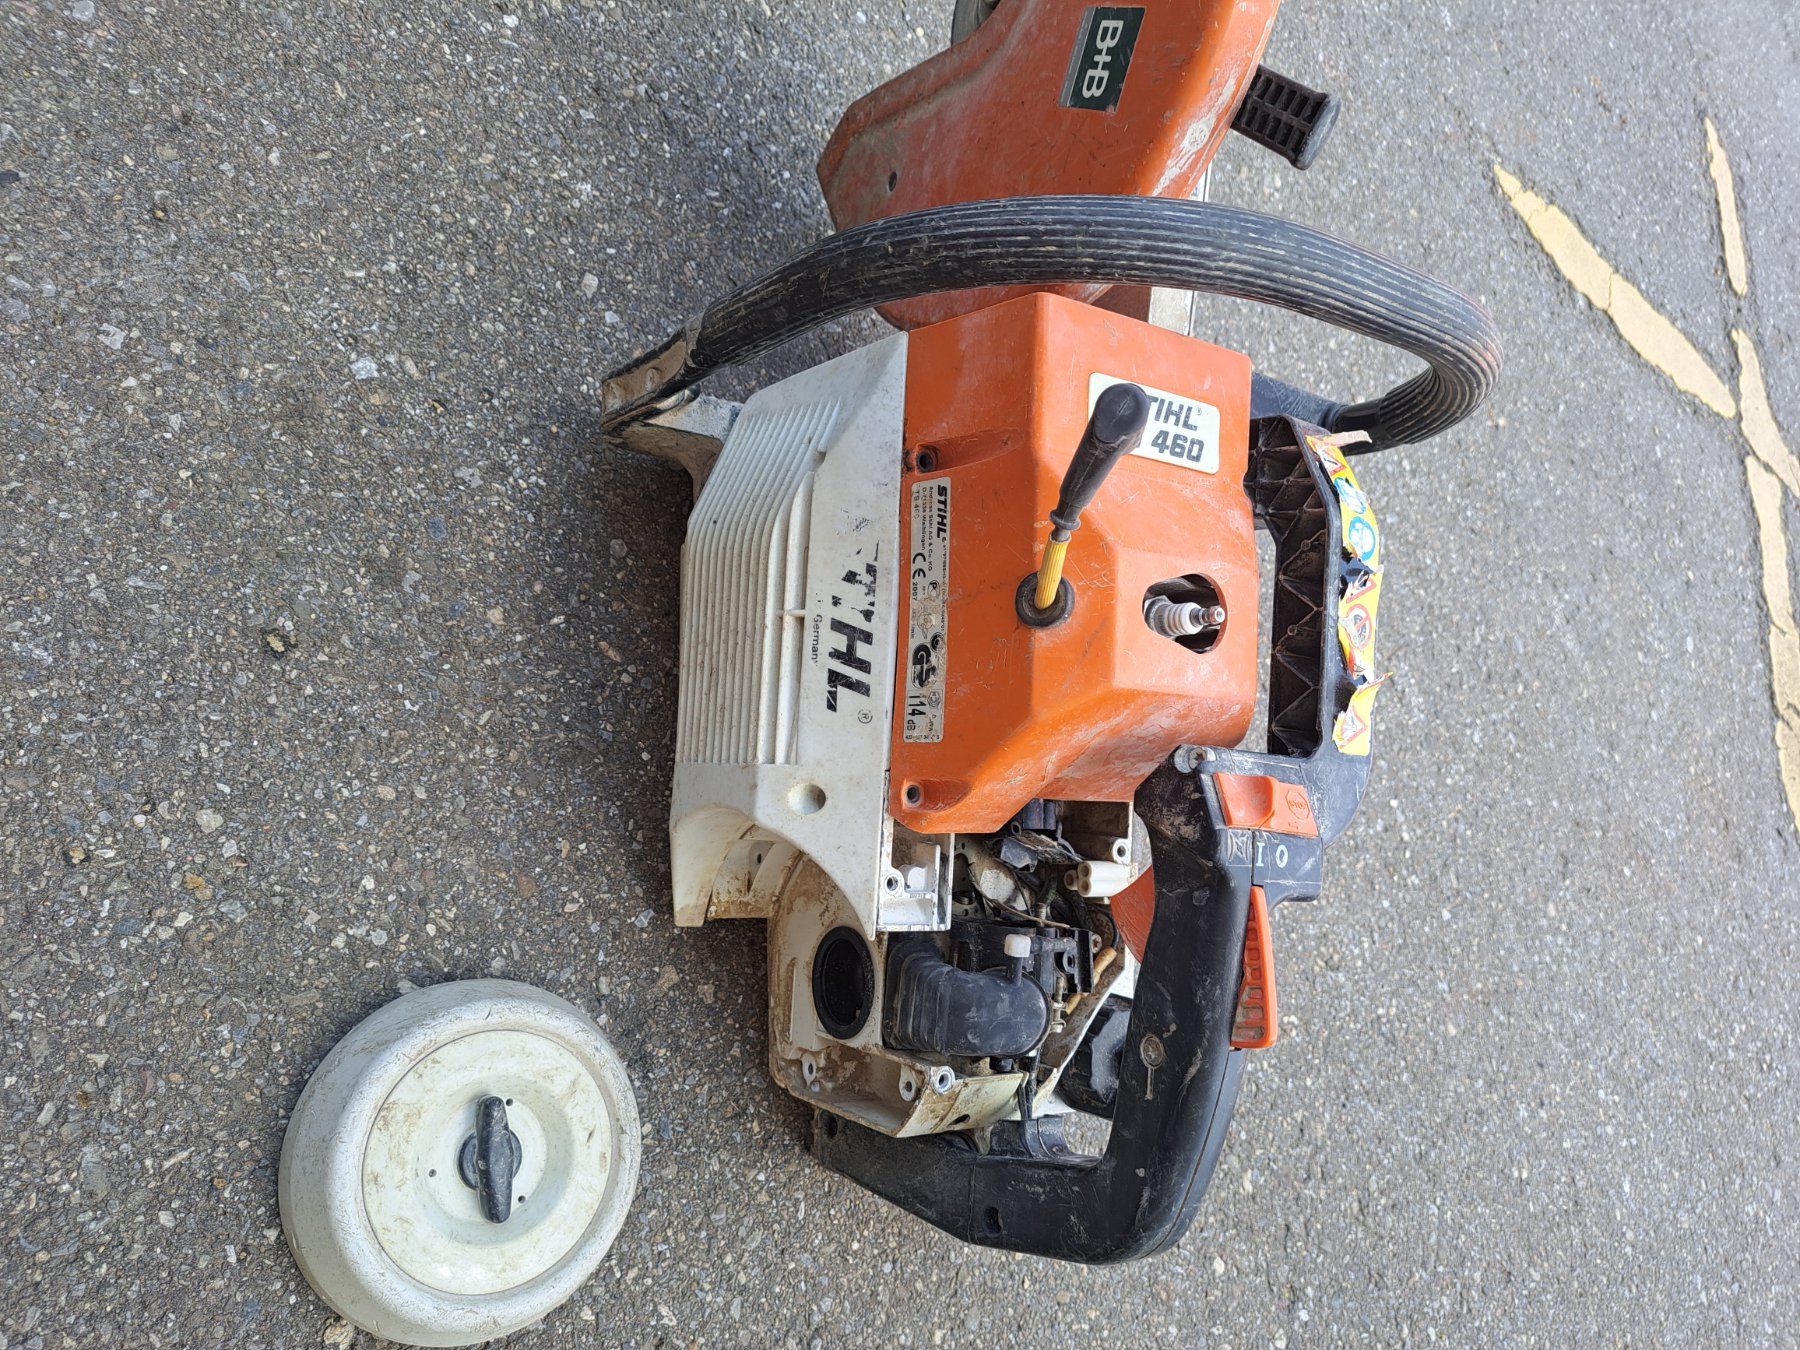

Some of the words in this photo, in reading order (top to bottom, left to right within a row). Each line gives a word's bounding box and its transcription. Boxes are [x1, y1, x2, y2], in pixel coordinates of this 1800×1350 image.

[1082, 19, 1124, 98] B+B
[1146, 394, 1198, 431] IHL
[1151, 430, 1204, 463] 460
[936, 484, 948, 539] STIHL
[928, 530, 933, 541] AG
[908, 693, 927, 717] 114
[907, 719, 916, 731] dB
